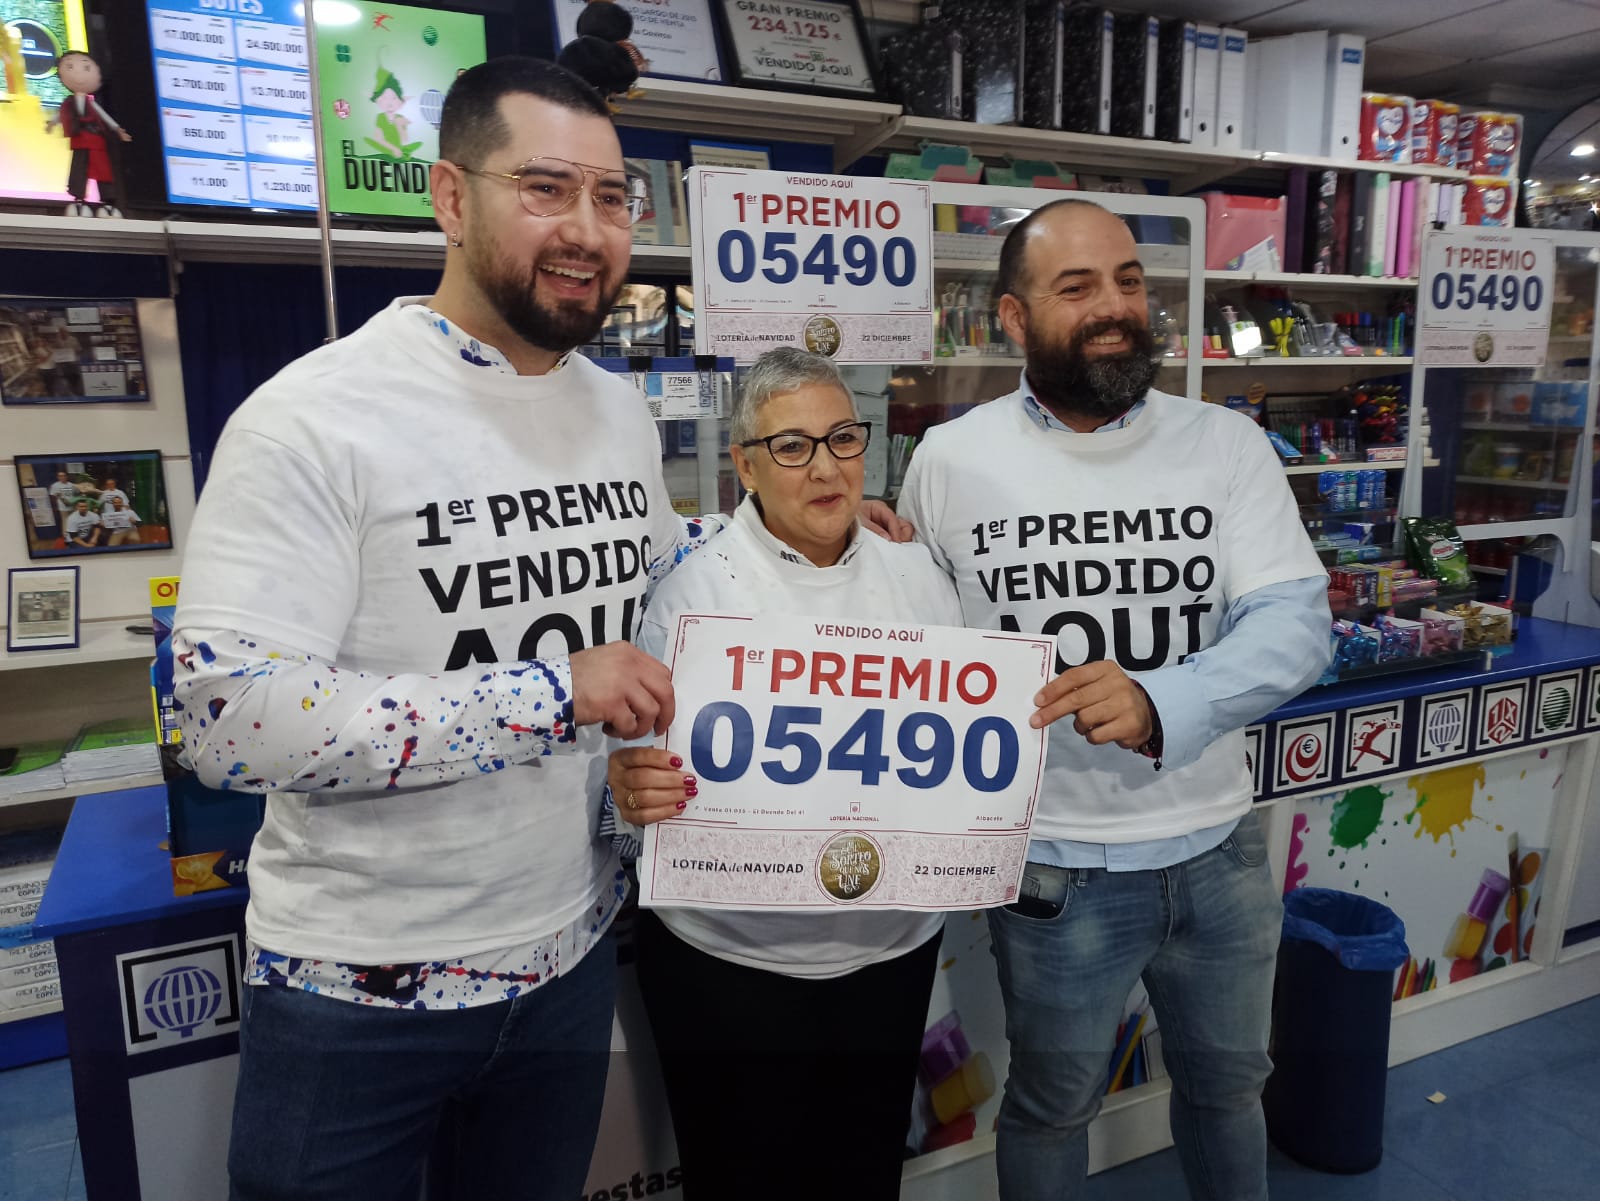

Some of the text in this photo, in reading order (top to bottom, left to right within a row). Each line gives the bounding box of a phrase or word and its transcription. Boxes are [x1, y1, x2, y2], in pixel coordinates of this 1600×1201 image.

[736, 1, 840, 23] GRAN PREMIO
[245, 39, 304, 54] 24.500.000
[755, 56, 816, 72] VENDIDO
[172, 77, 227, 92] 2.700.000
[183, 127, 227, 140] 850.000
[263, 182, 313, 193] 1.230.000
[344, 158, 433, 195] DUEND
[787, 175, 854, 189] VENDIDO AQUÍ
[762, 193, 901, 230] PREMIO
[717, 229, 917, 287] 05490
[1460, 247, 1537, 271] PREMIO
[1431, 271, 1544, 312] 05490
[872, 334, 912, 342] DICIEMBRE
[667, 375, 693, 384] 77566
[415, 480, 649, 548] 1er PREMIO
[971, 505, 1213, 556] 1er PREMIO
[418, 534, 652, 614] VENDIDO
[976, 555, 1215, 603] VENDIDO
[444, 592, 648, 672] AQU
[814, 623, 925, 643] VENDIDO AQUÍ
[725, 645, 998, 706] 1er PREMIO
[690, 700, 1020, 793] 05490
[672, 858, 728, 872] LOTERÍA
[743, 862, 804, 875] NAVIDAD
[914, 865, 997, 877] 22 DICIEMBRE
